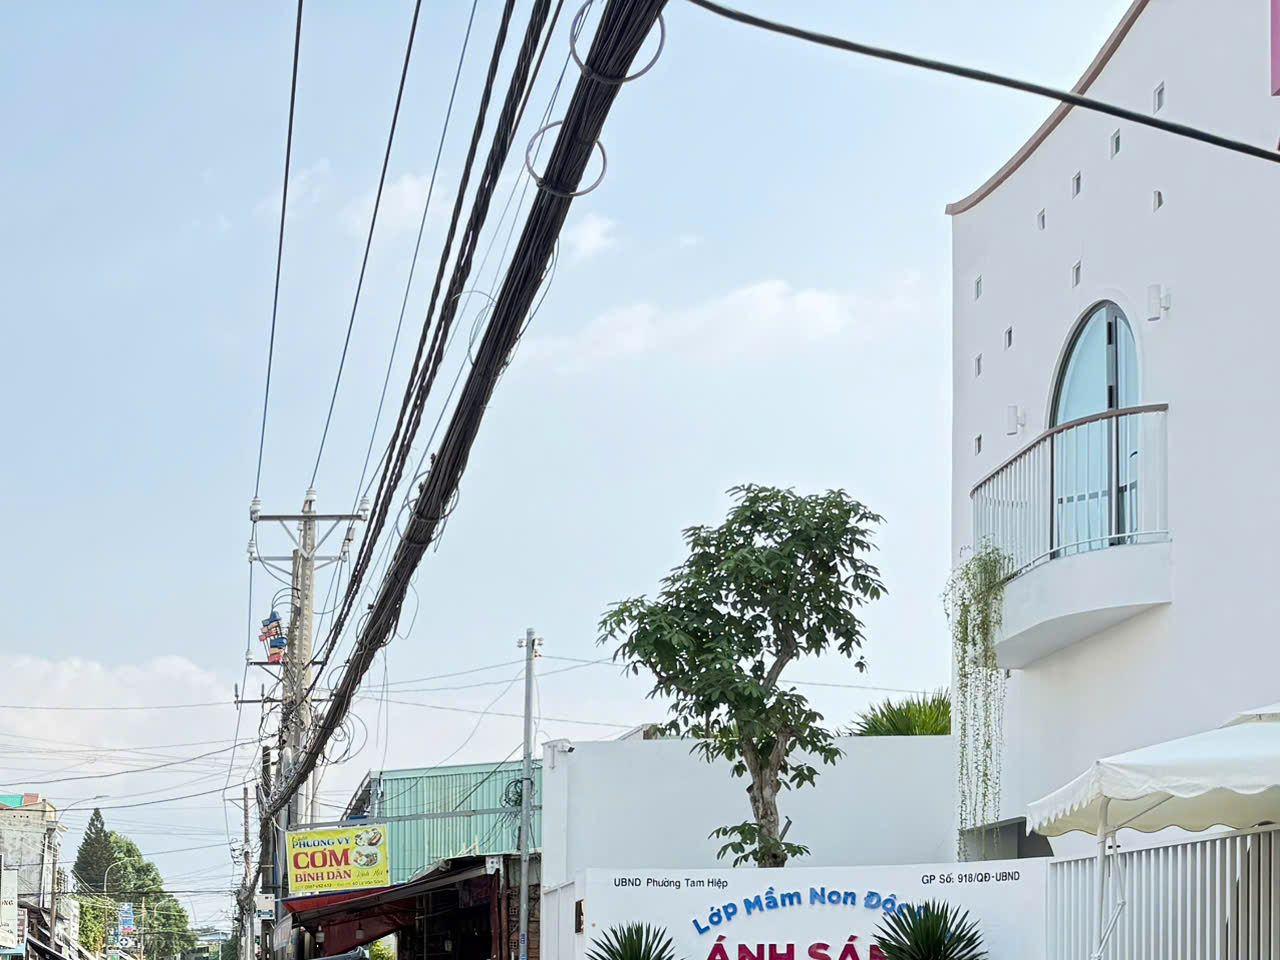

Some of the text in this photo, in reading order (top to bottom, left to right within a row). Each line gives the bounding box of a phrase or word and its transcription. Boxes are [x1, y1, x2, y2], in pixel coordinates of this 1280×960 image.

[293, 848, 351, 870] CƠM
[614, 877, 728, 889] UBND Phường Tam Hiệp
[921, 874, 936, 885] GP
[939, 873, 955, 884] Số:
[692, 901, 738, 935] Lớp
[743, 886, 802, 916] Mầm
[809, 886, 857, 906] Non
